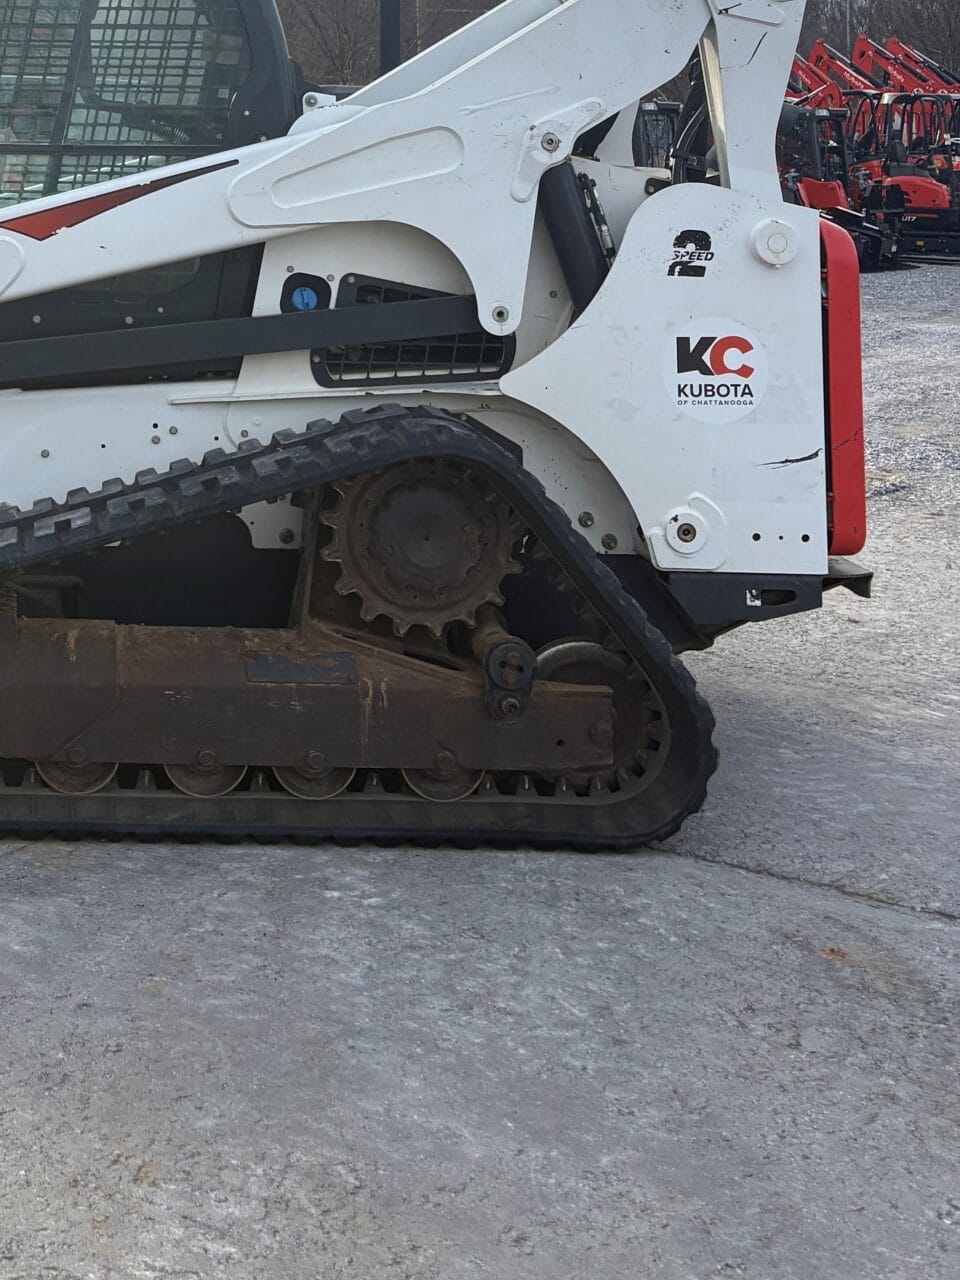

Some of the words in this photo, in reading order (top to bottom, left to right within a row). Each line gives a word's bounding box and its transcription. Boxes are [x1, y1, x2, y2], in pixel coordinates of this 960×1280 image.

[667, 229, 712, 278] 2
[672, 250, 715, 261] SPEED
[676, 335, 755, 379] KC
[677, 383, 754, 398] KUBOTA
